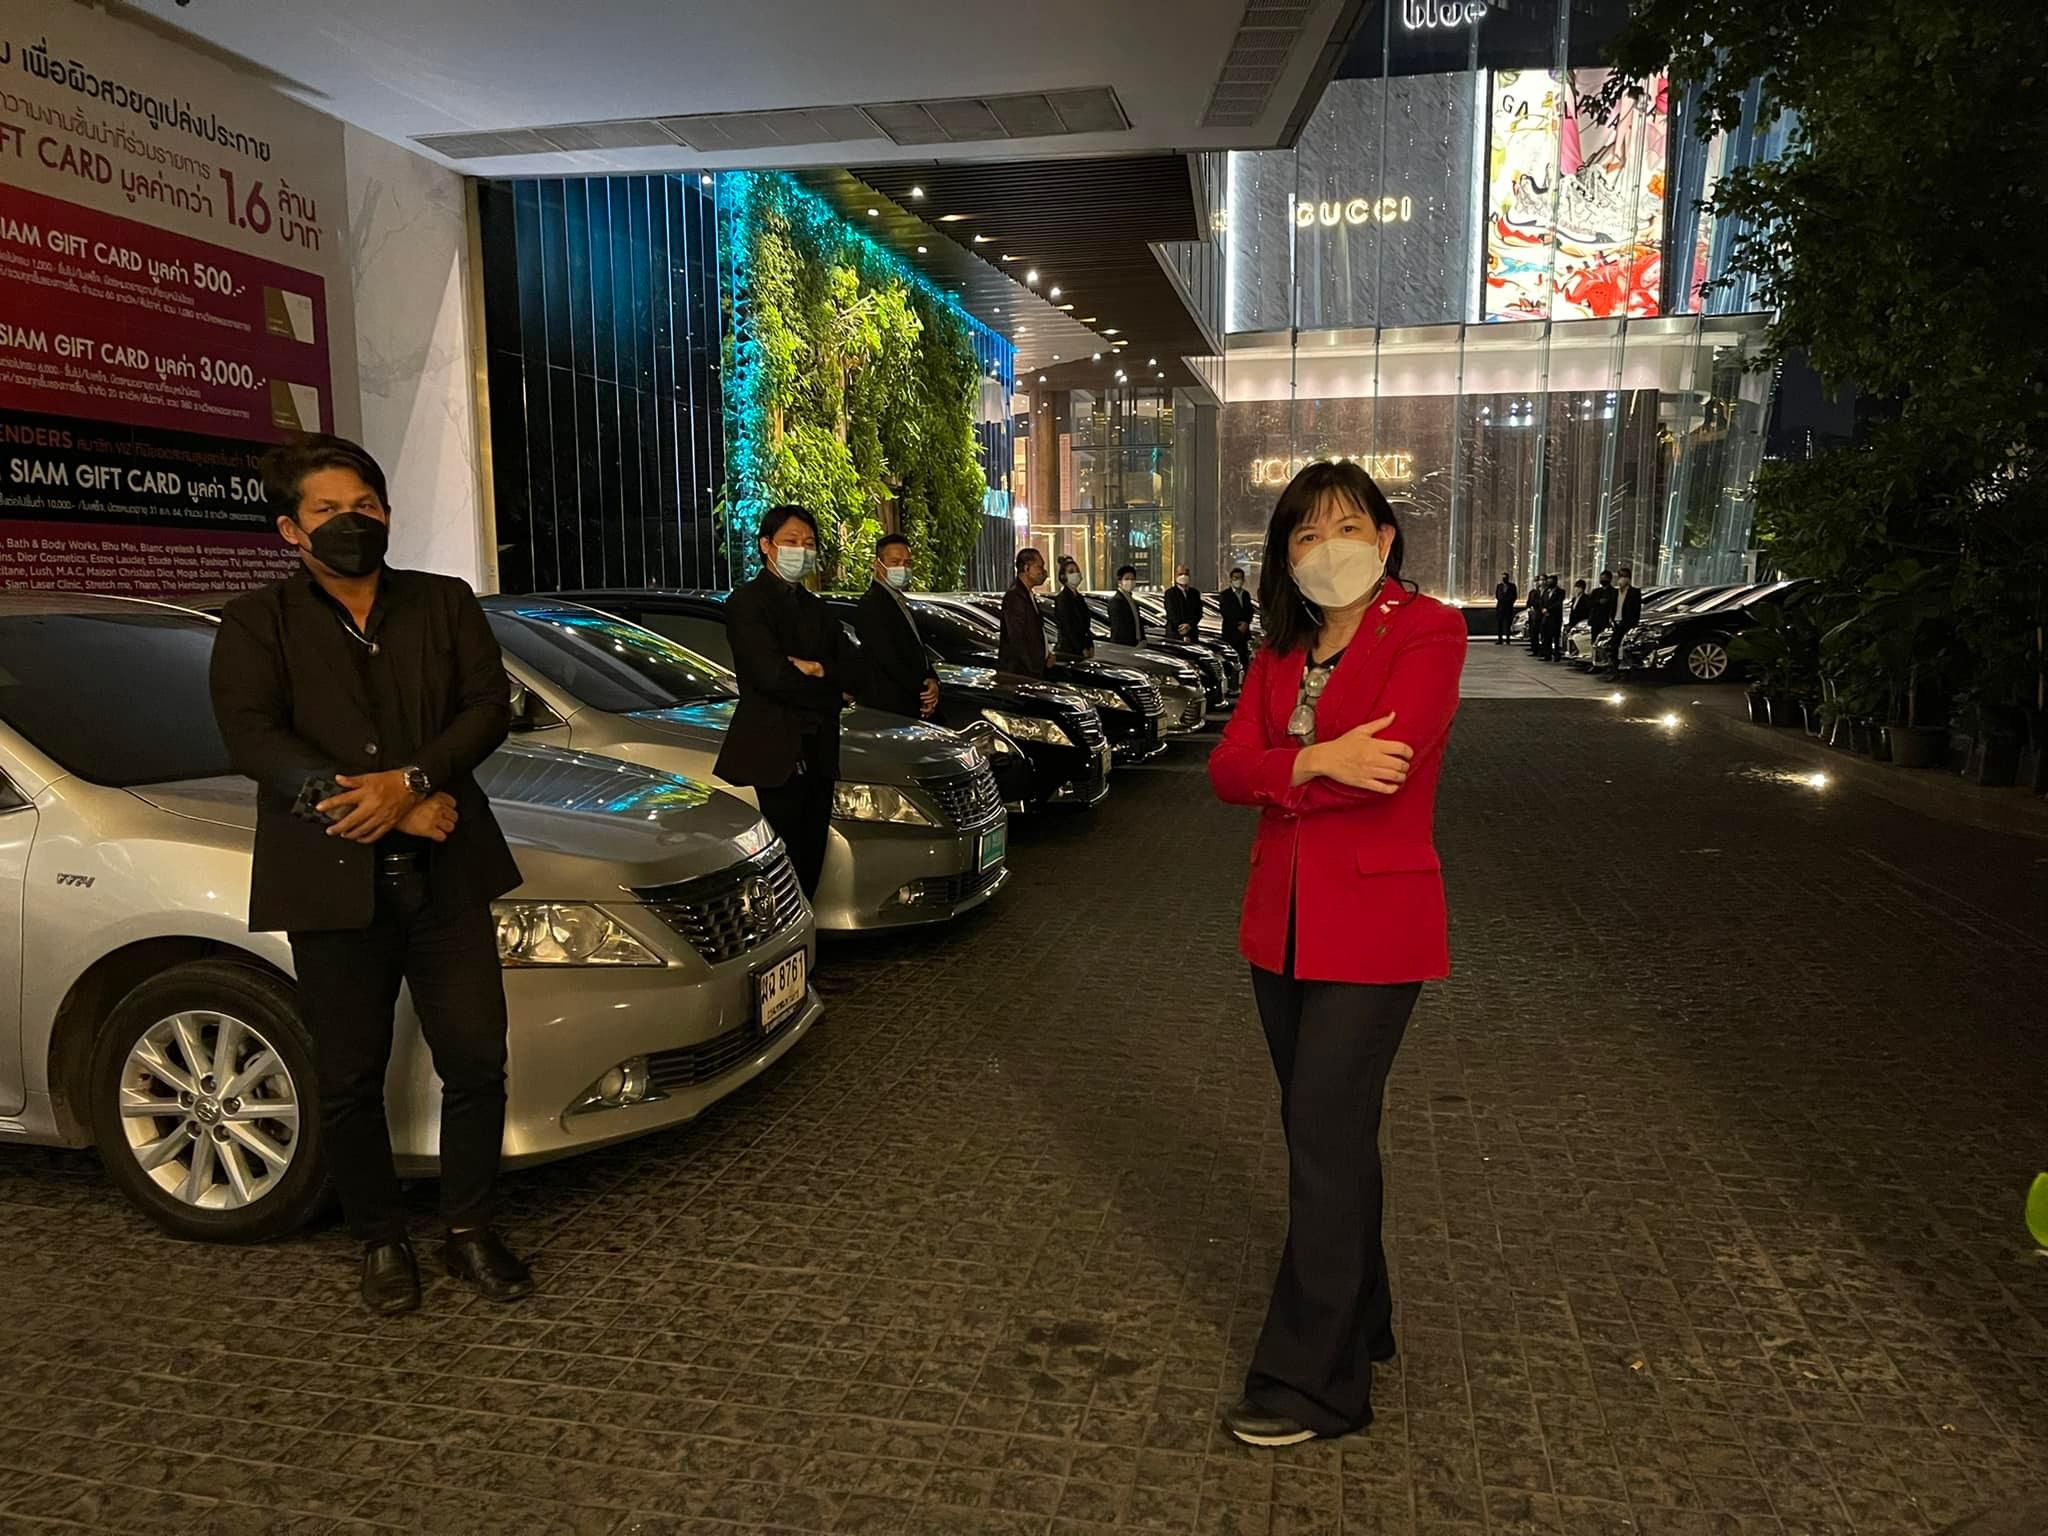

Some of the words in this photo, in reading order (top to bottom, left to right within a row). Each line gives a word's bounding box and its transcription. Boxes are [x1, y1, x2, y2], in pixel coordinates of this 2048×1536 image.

[37, 136, 112, 184] CARD
[120, 168, 214, 218] มูลค่ากว่า
[219, 167, 272, 235] 1.6
[278, 177, 316, 222] ล้าน
[1296, 196, 1412, 228] GUCCI
[0, 216, 42, 248] IAM
[47, 229, 88, 259] GIFT
[93, 242, 143, 272] CARD
[148, 258, 190, 284] มูลค่า
[0, 322, 48, 353] SIAM
[54, 333, 95, 361] GIFT
[100, 343, 149, 370] CARD
[155, 352, 197, 380] มูลค่า
[9, 457, 70, 487] SIAM
[75, 463, 122, 490] GIFT
[127, 468, 182, 495] CARD
[187, 475, 227, 504] มูลค่า
[1250, 453, 1414, 484] ICOXE
[6, 537, 30, 549] Bath
[31, 538, 39, 549] &
[41, 538, 66, 551] Body
[17, 552, 38, 563] Dior
[779, 952, 804, 991] 8761
